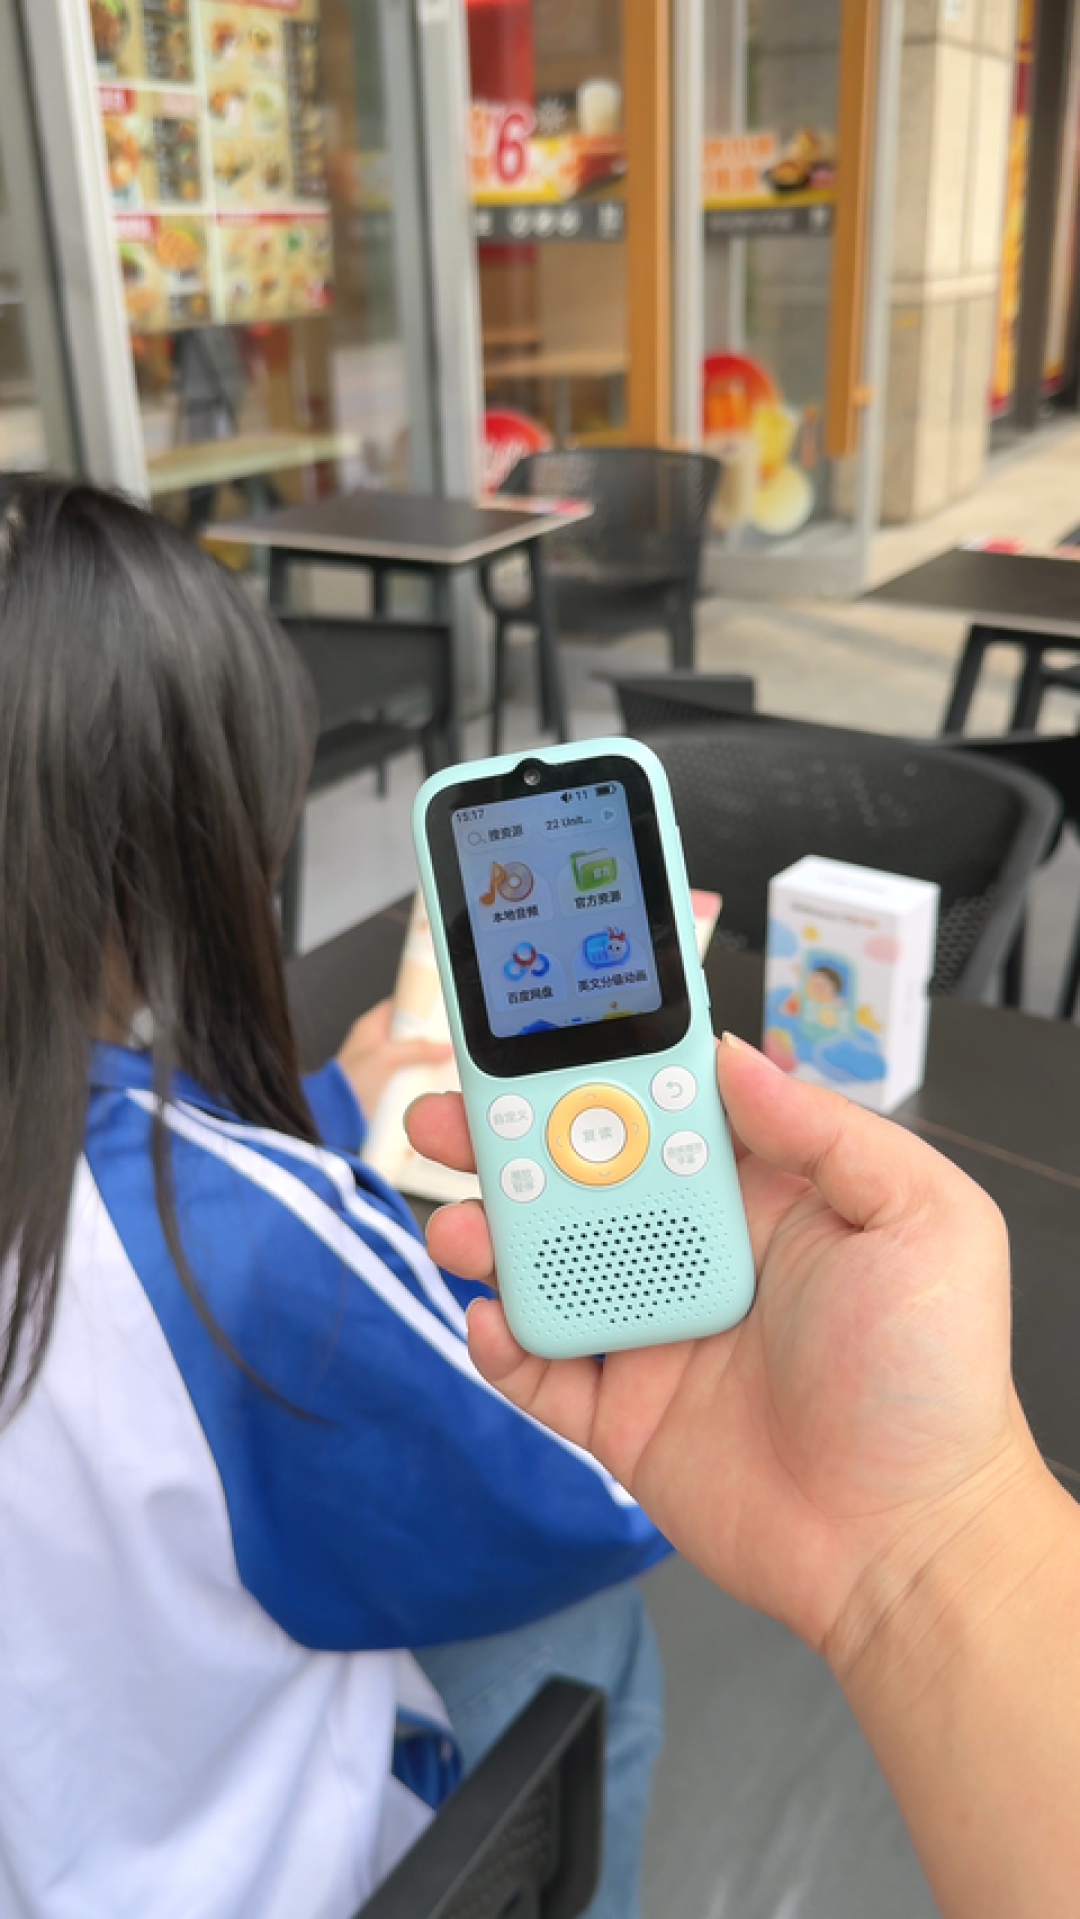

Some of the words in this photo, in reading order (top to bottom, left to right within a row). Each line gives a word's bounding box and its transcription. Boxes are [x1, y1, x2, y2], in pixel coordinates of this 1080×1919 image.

[497, 112, 526, 184] 6
[576, 790, 588, 800] 11
[456, 809, 485, 822] 15:17
[546, 819, 559, 831] 22
[488, 824, 524, 843] 搜资源
[574, 890, 622, 910] 官方资源
[492, 904, 539, 924] 本地音频
[577, 969, 648, 993] 英文分级动画
[507, 985, 554, 1005] 百度网盘
[493, 1109, 529, 1126] 自定义
